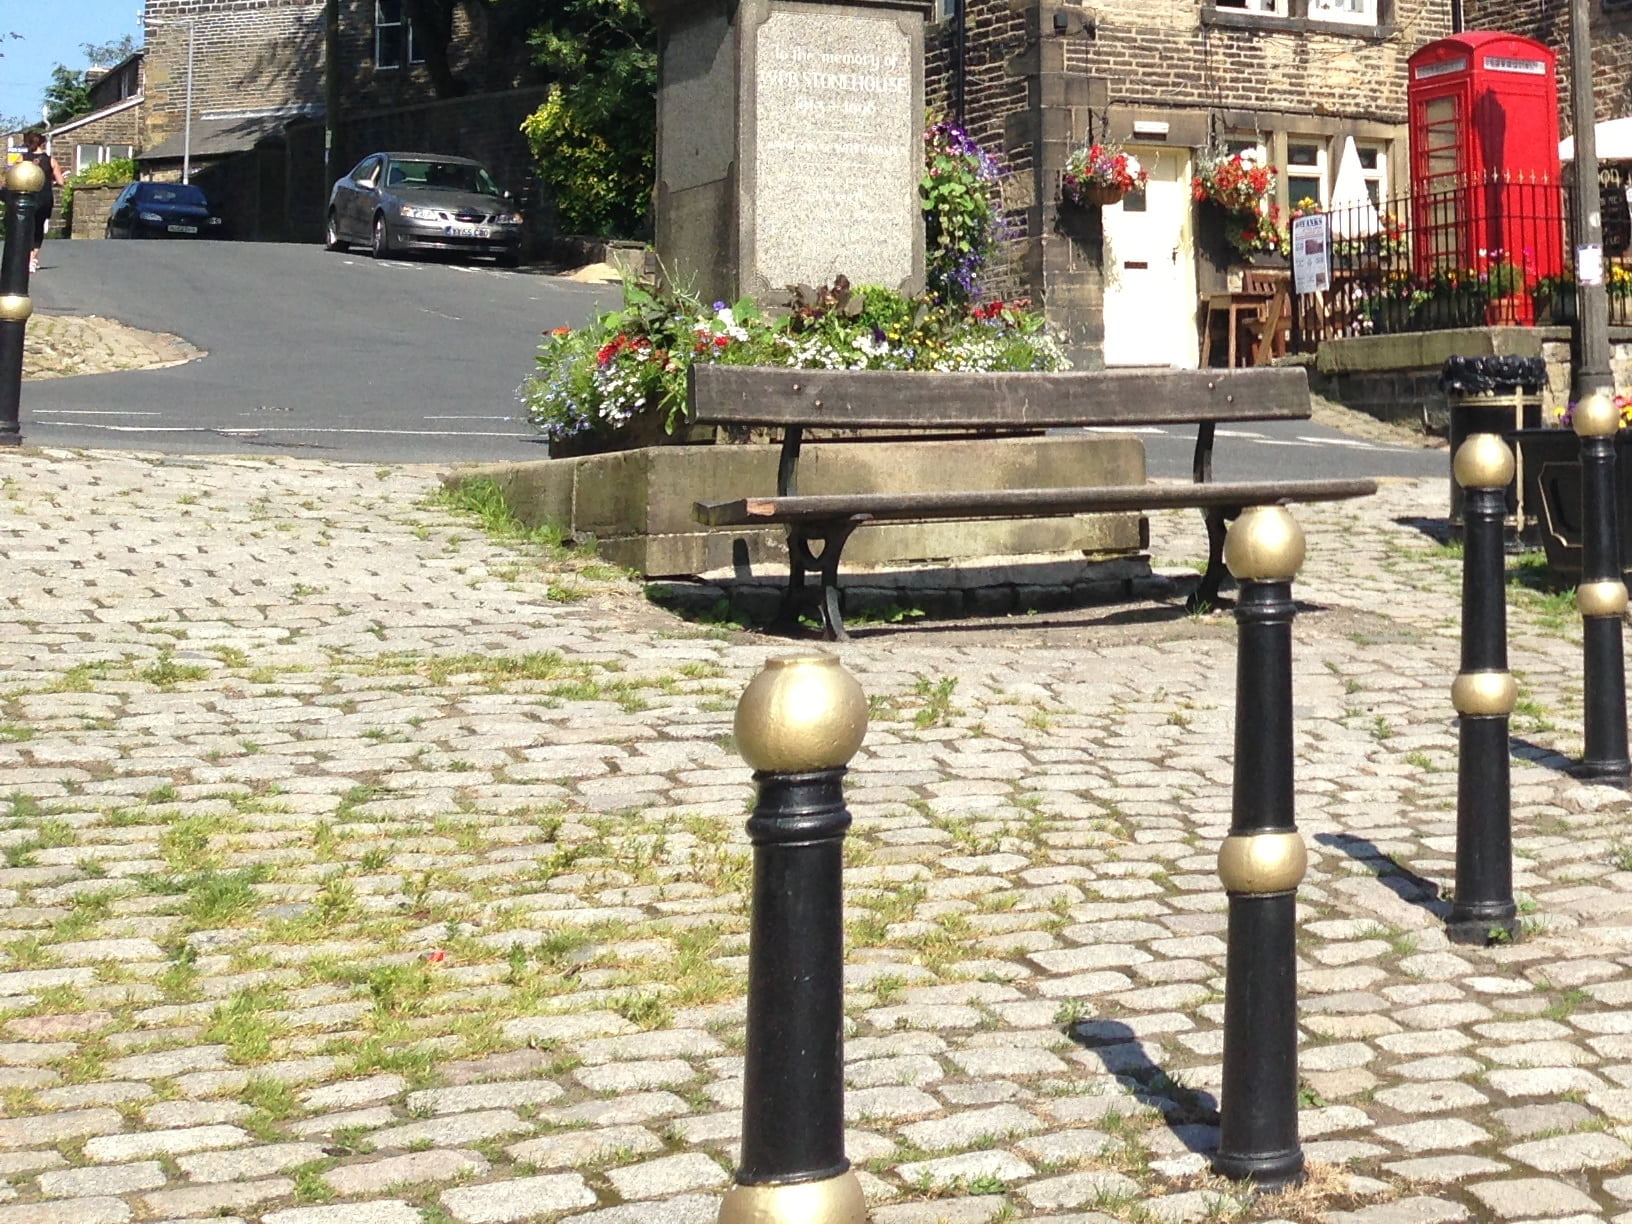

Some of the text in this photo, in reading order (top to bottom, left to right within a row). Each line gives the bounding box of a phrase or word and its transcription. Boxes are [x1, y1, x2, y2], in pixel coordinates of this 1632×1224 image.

[822, 52, 879, 71] memory
[884, 53, 898, 71] of
[803, 70, 906, 93] STONEHOUSE
